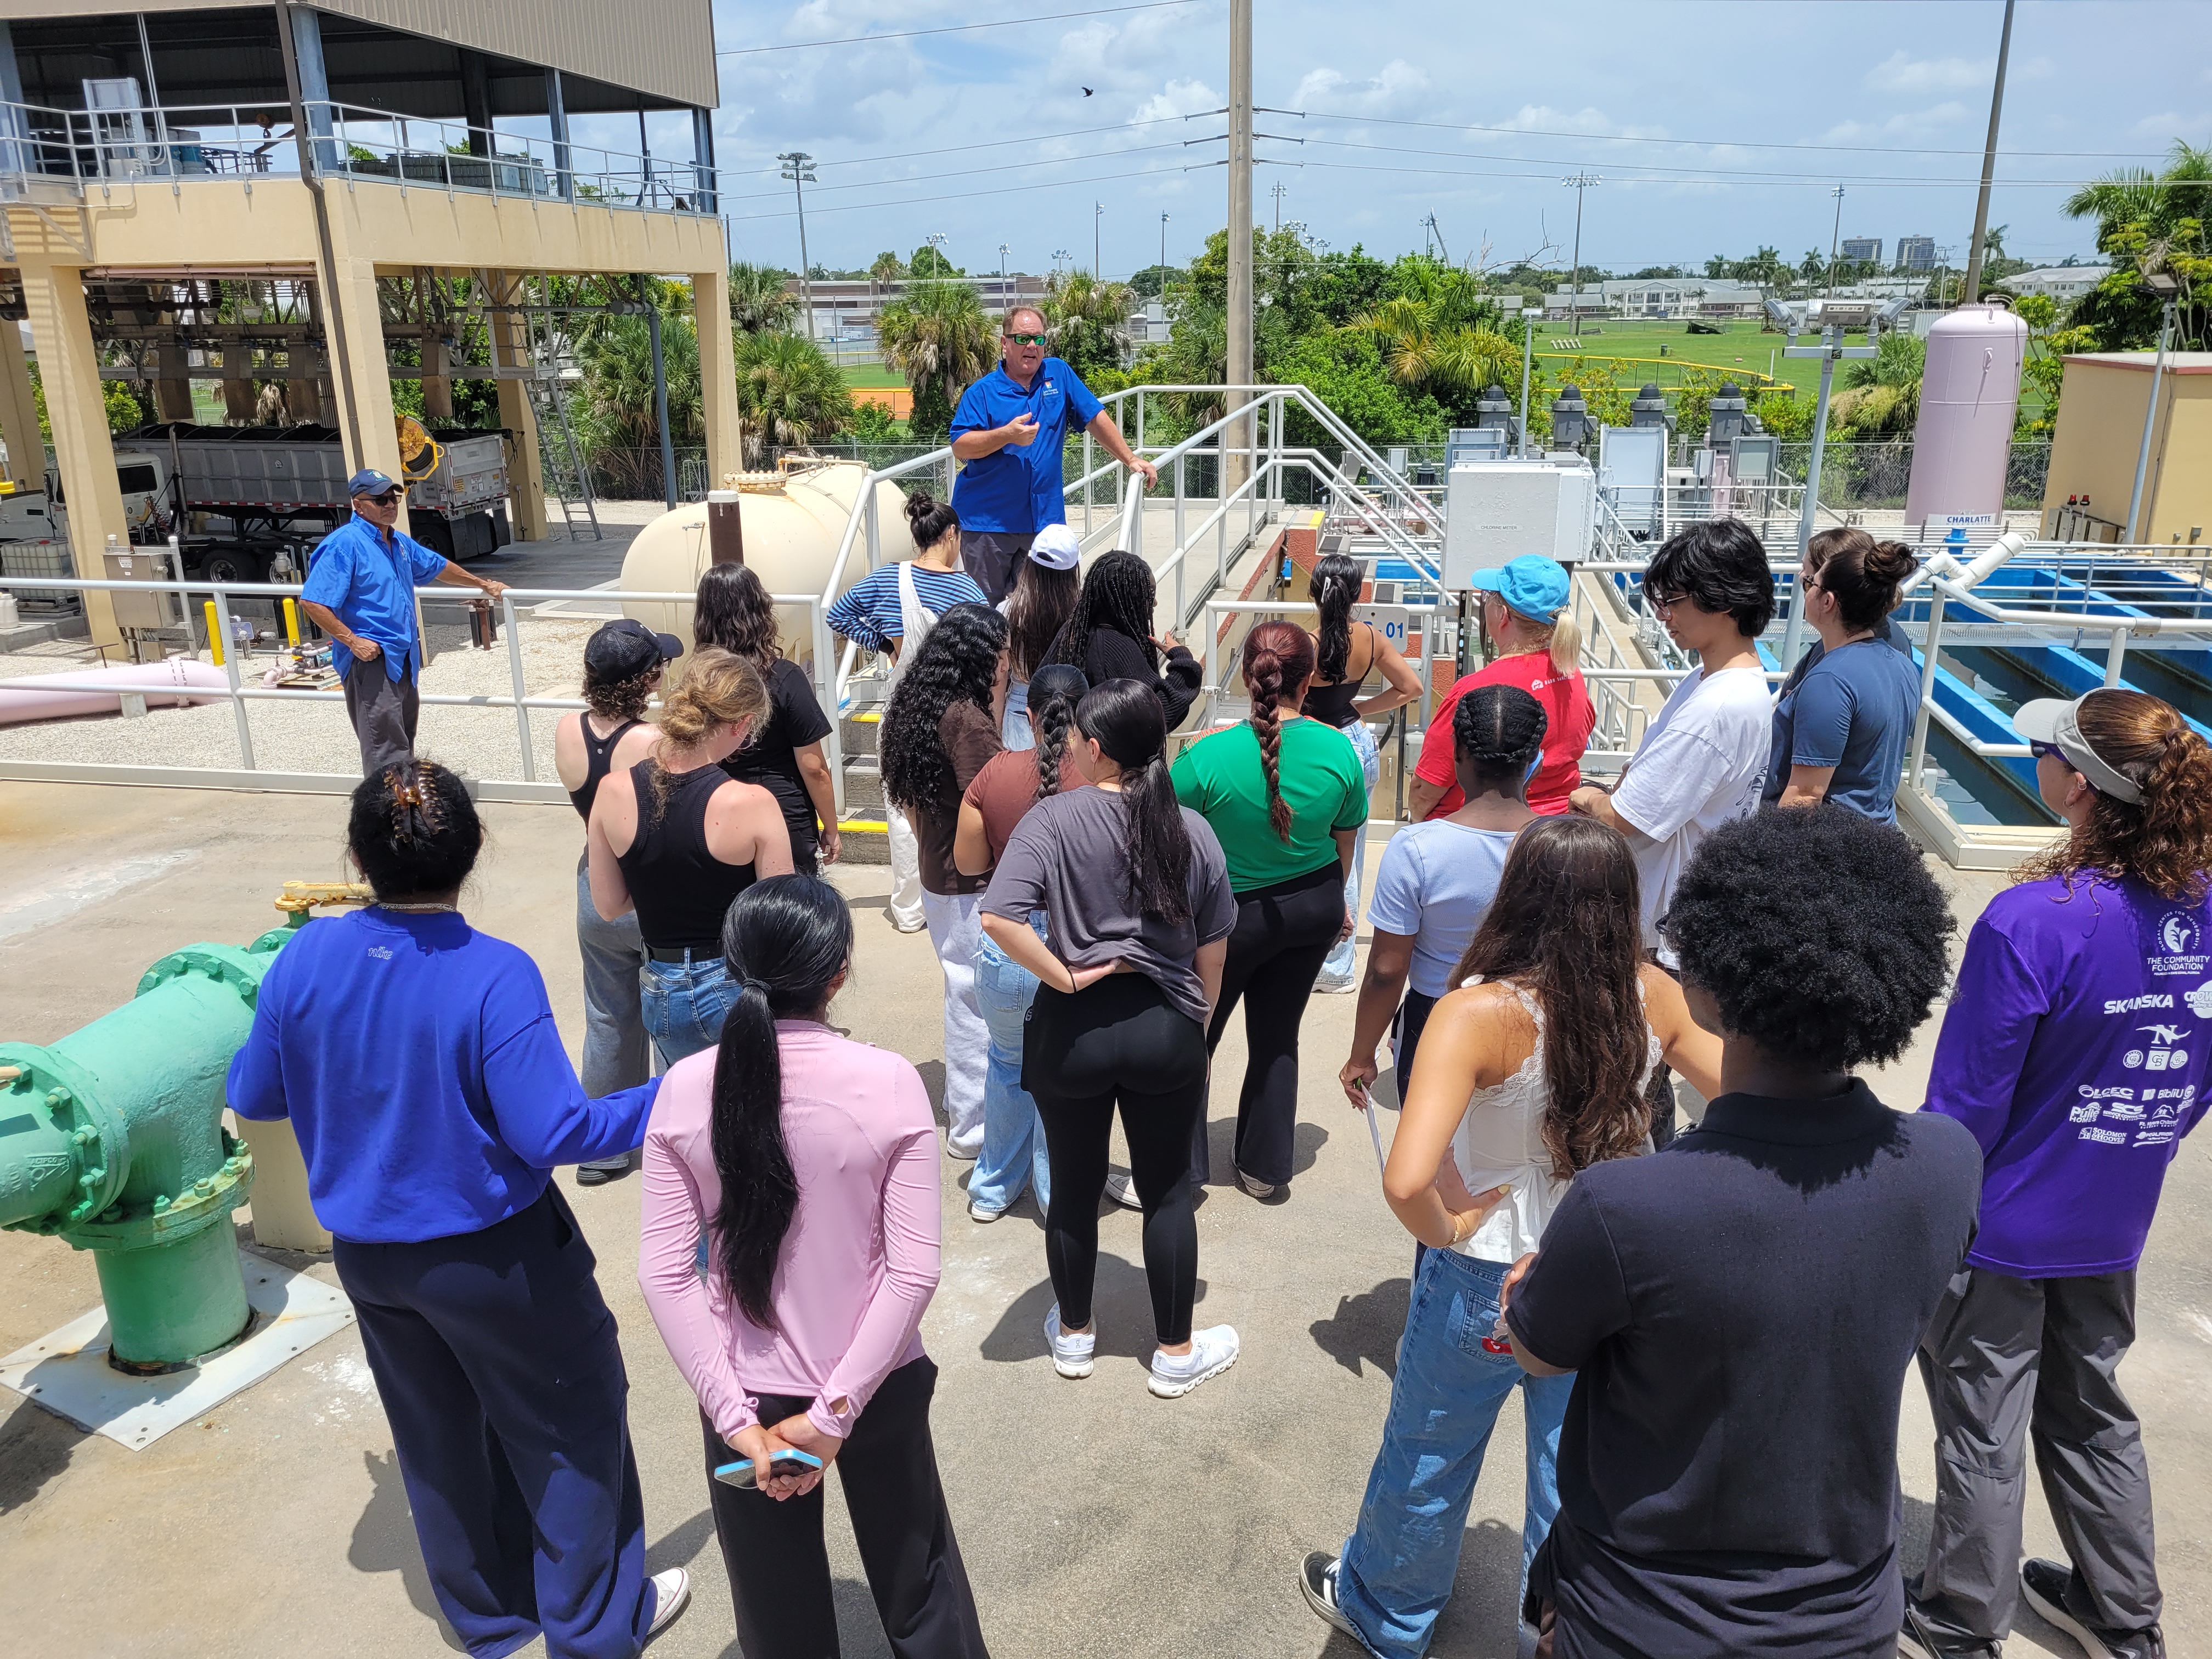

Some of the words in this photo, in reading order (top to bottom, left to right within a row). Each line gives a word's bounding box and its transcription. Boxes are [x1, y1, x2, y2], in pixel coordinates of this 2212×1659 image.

[368, 946, 393, 960] nike
[2152, 963, 2204, 972] FOUNDATION
[2104, 995, 2174, 1014] SKANSKA
[2094, 1087, 2134, 1097] LCEC
[2157, 1088, 2184, 1099] BibliU
[2093, 1127, 2127, 1137] SOLOMON
